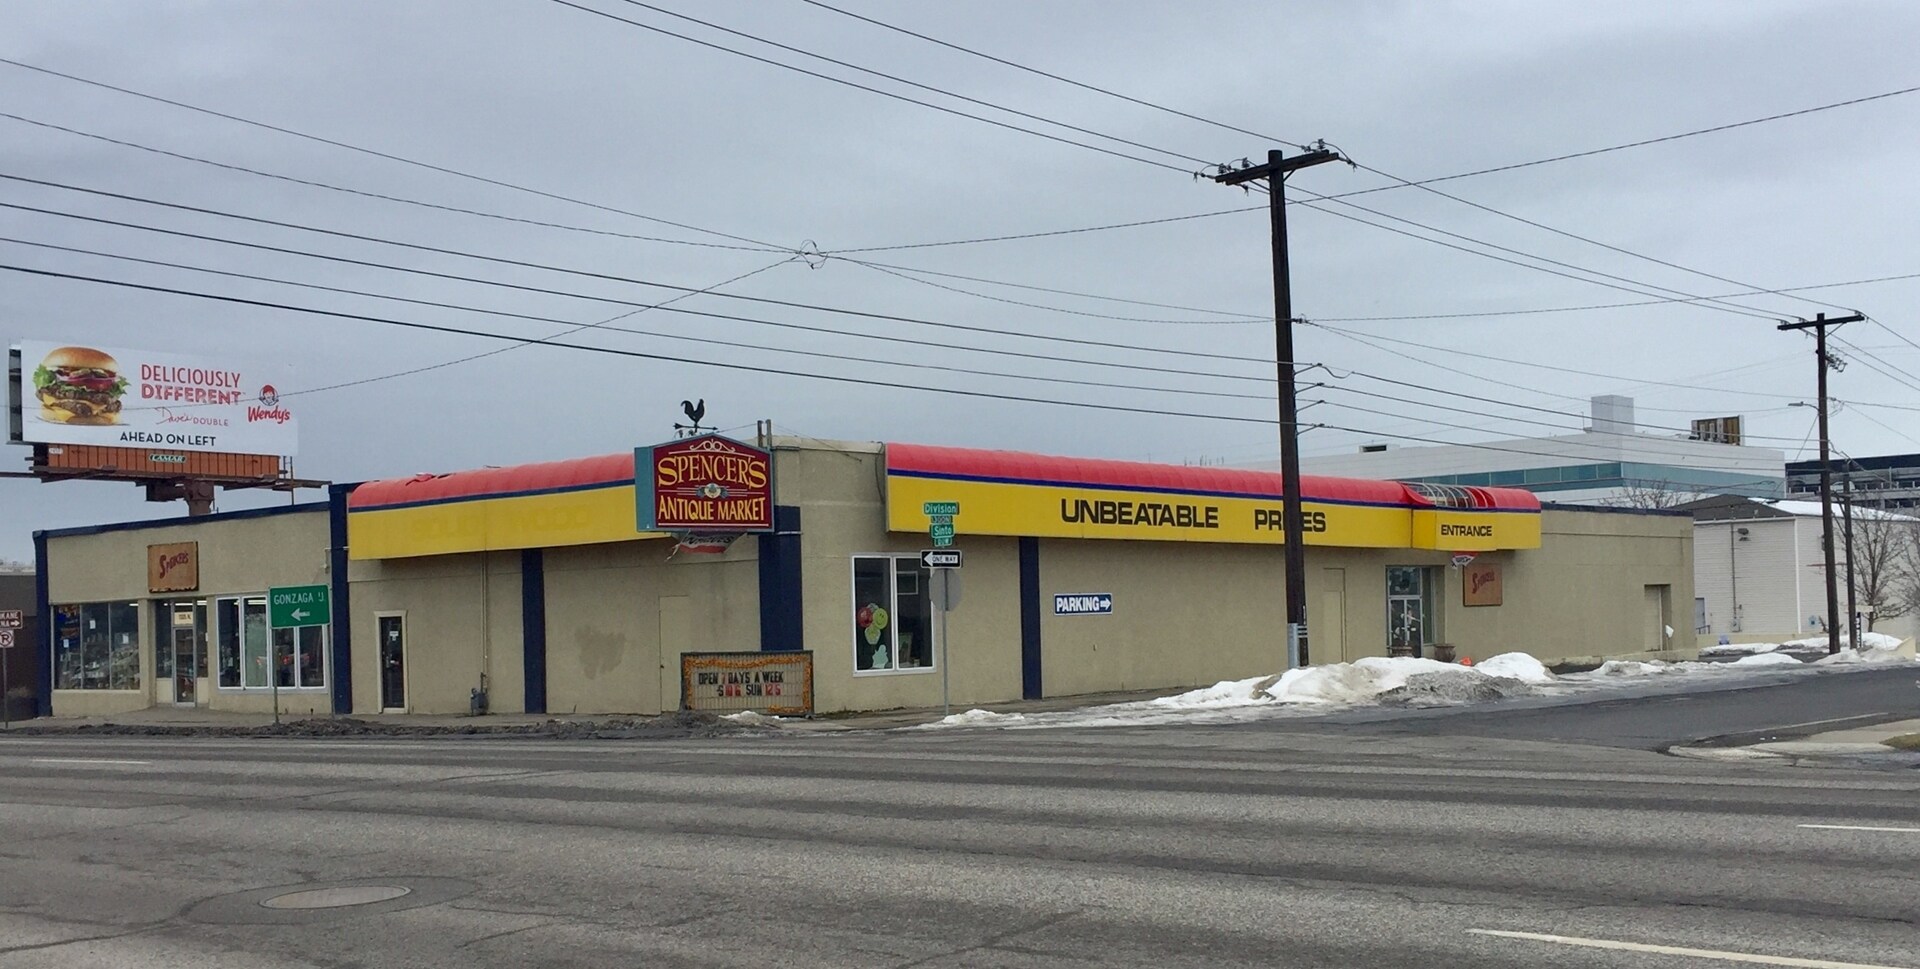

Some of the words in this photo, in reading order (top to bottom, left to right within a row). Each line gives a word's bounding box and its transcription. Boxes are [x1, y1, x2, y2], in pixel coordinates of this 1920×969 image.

[141, 364, 240, 388] DELICIOUSLY
[141, 383, 242, 405] DIFFERENT
[193, 416, 229, 427] DOUBLE
[248, 405, 290, 424] Wendy's
[120, 431, 163, 443] AHEAD
[166, 433, 185, 444] ON
[188, 435, 216, 446] LEFT
[658, 454, 767, 489] SPENCER'S
[658, 495, 714, 520] ANTIQUE
[717, 497, 766, 521] MARKET
[924, 503, 957, 514] Division
[1061, 498, 1219, 528] UNBEATABLE
[1255, 509, 1326, 532] PRES
[934, 525, 952, 536] Sinto
[1441, 524, 1492, 537] ENTRANCE
[273, 592, 314, 605] GONZAGA
[1056, 595, 1100, 613] PARKING
[698, 672, 718, 685] OPEN
[728, 671, 750, 684] DAYS
[754, 671, 760, 683] A
[762, 670, 784, 683] WEEK
[746, 684, 762, 696] SUN
